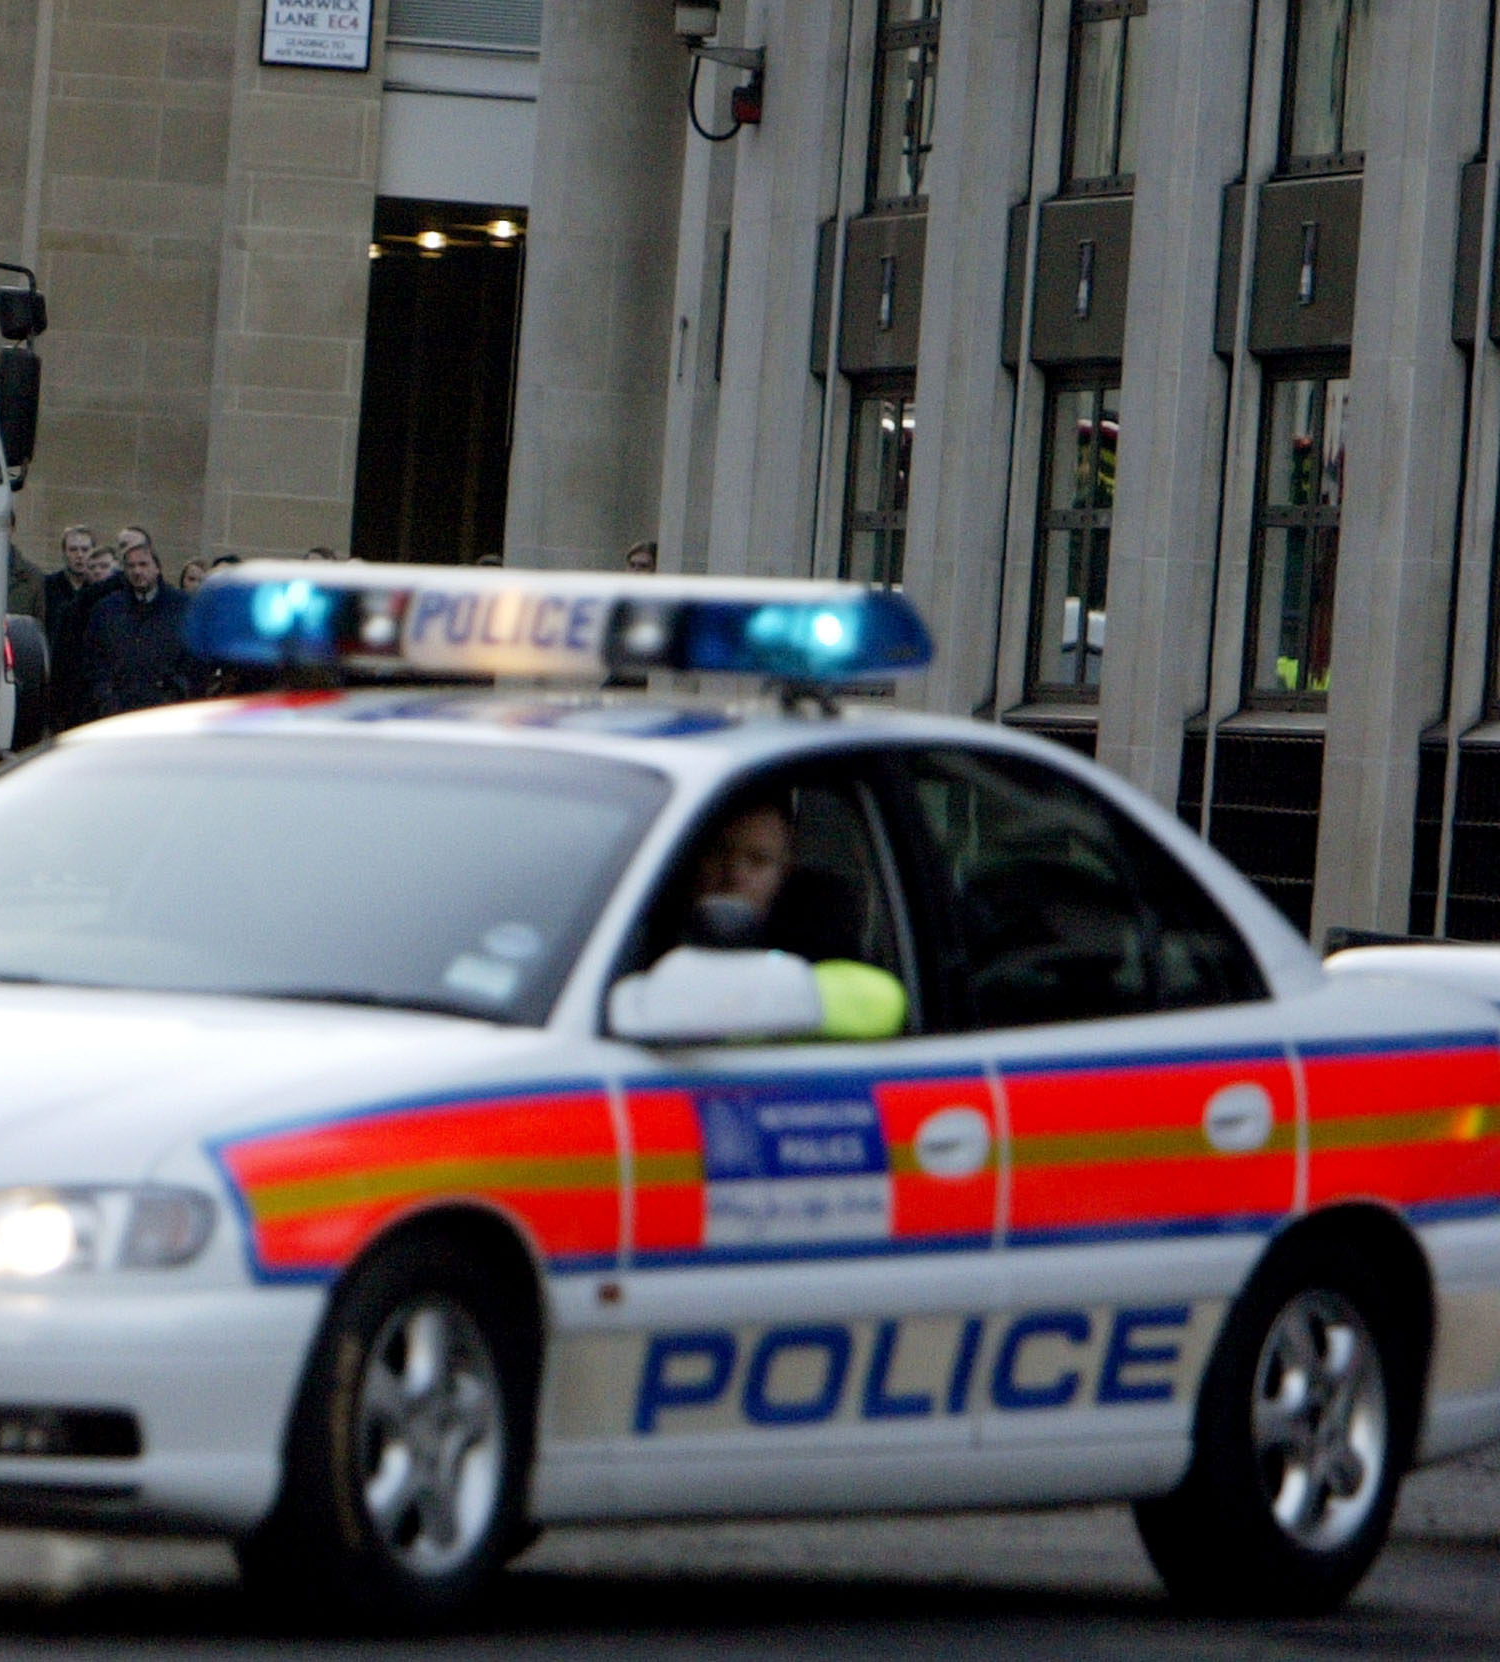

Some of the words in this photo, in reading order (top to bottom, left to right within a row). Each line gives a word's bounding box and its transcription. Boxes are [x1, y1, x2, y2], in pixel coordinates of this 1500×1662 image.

[275, 11, 318, 27] LANE
[328, 14, 359, 30] EC4
[412, 590, 599, 649] POLICE
[631, 1304, 1192, 1435] POLICE
